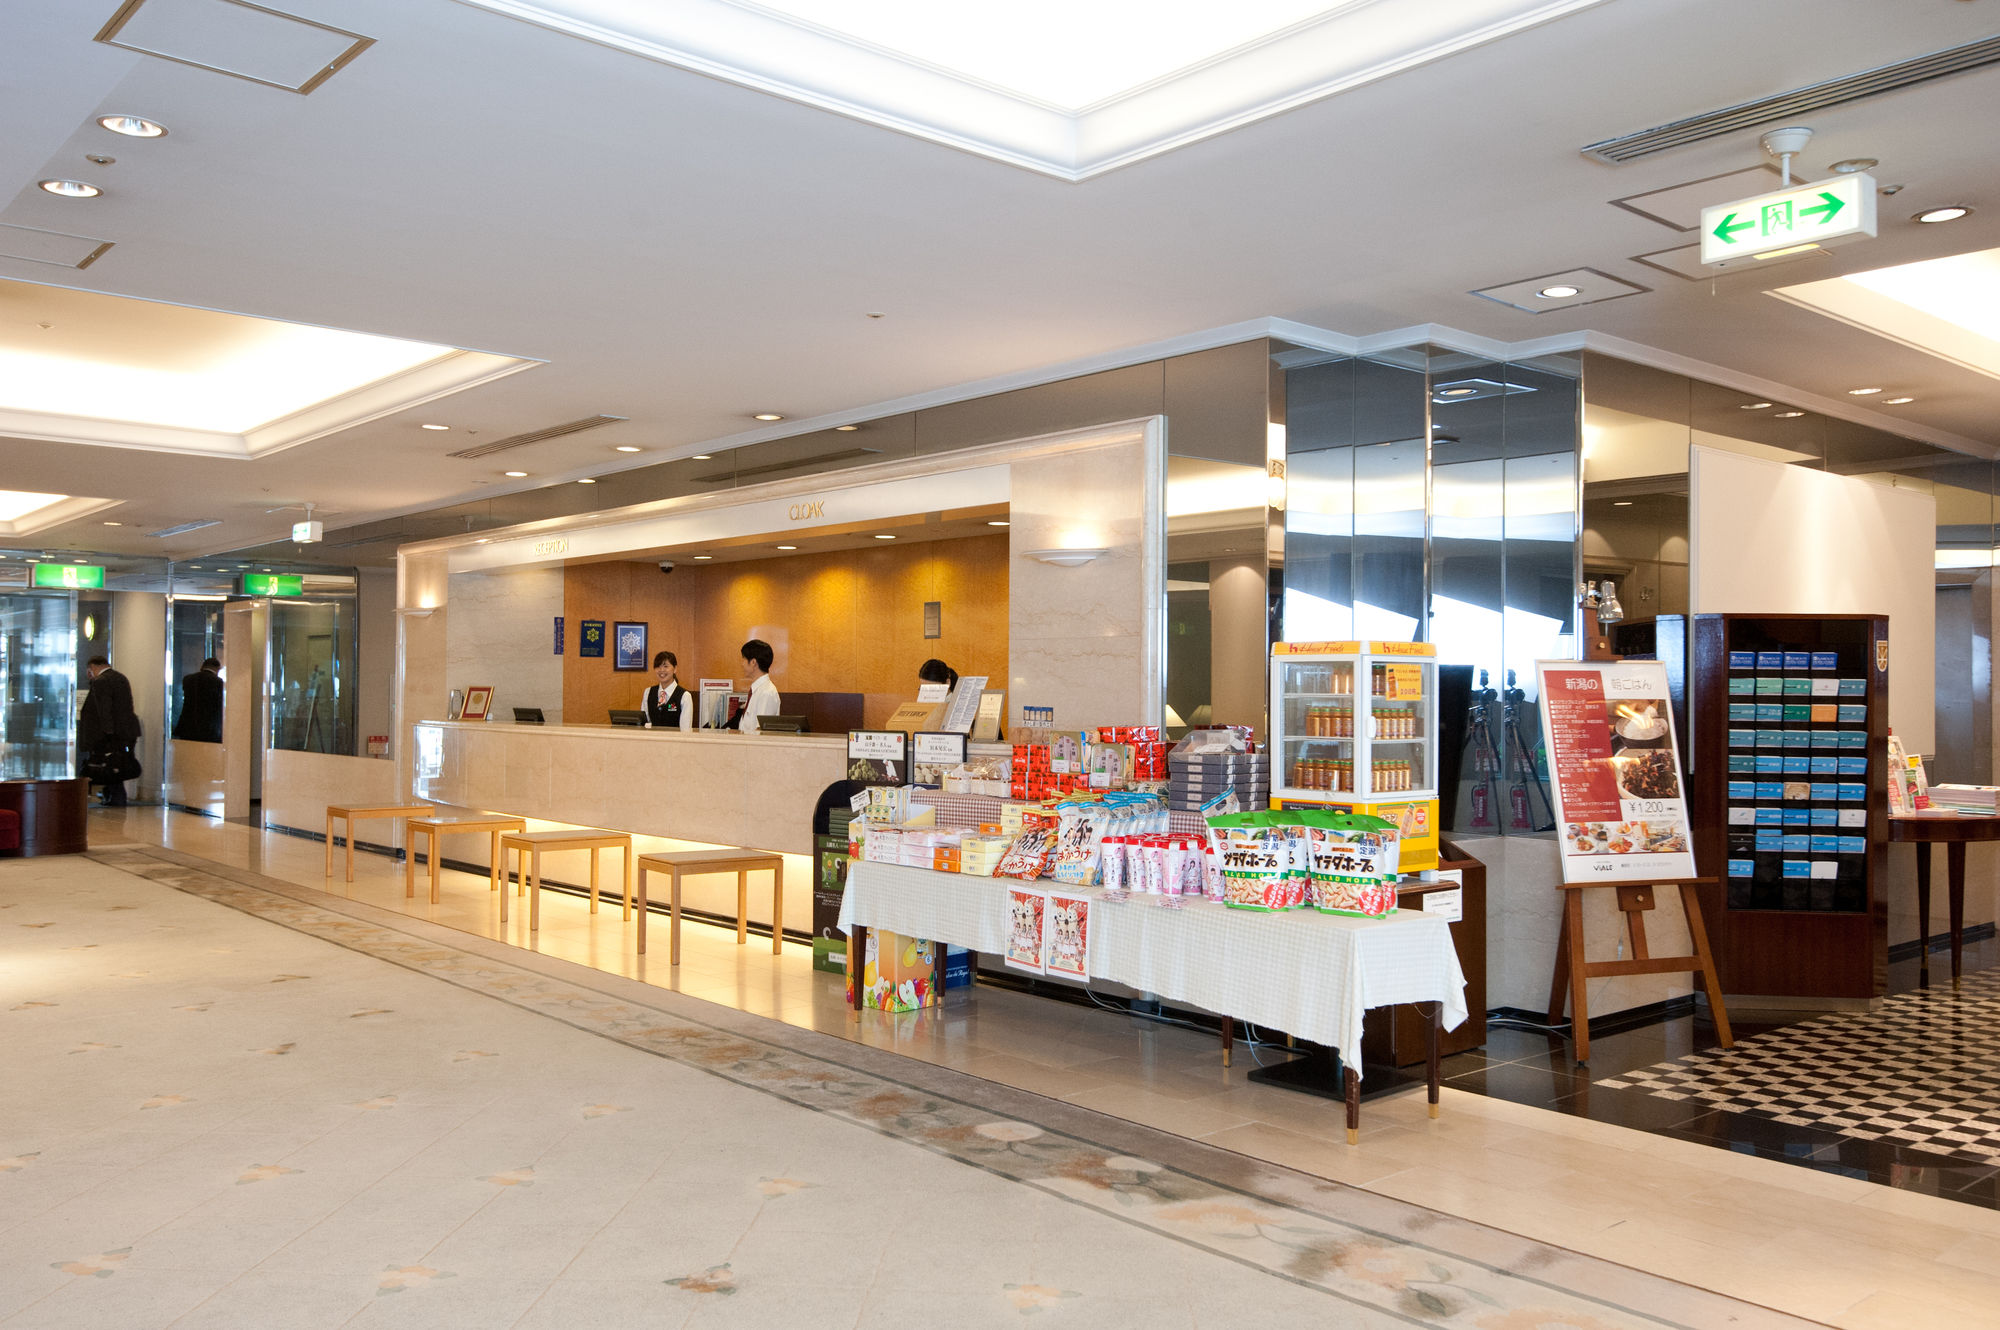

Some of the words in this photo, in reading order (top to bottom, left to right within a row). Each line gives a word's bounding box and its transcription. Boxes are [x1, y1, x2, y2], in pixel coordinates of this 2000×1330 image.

[788, 500, 825, 521] CLOAK
[534, 537, 569, 556] RECEPTION
[1299, 642, 1323, 653] House
[1323, 641, 1345, 653] Foods
[1391, 643, 1409, 653] House
[1409, 643, 1425, 654] Foods
[1565, 678, 1599, 691] 新潟の
